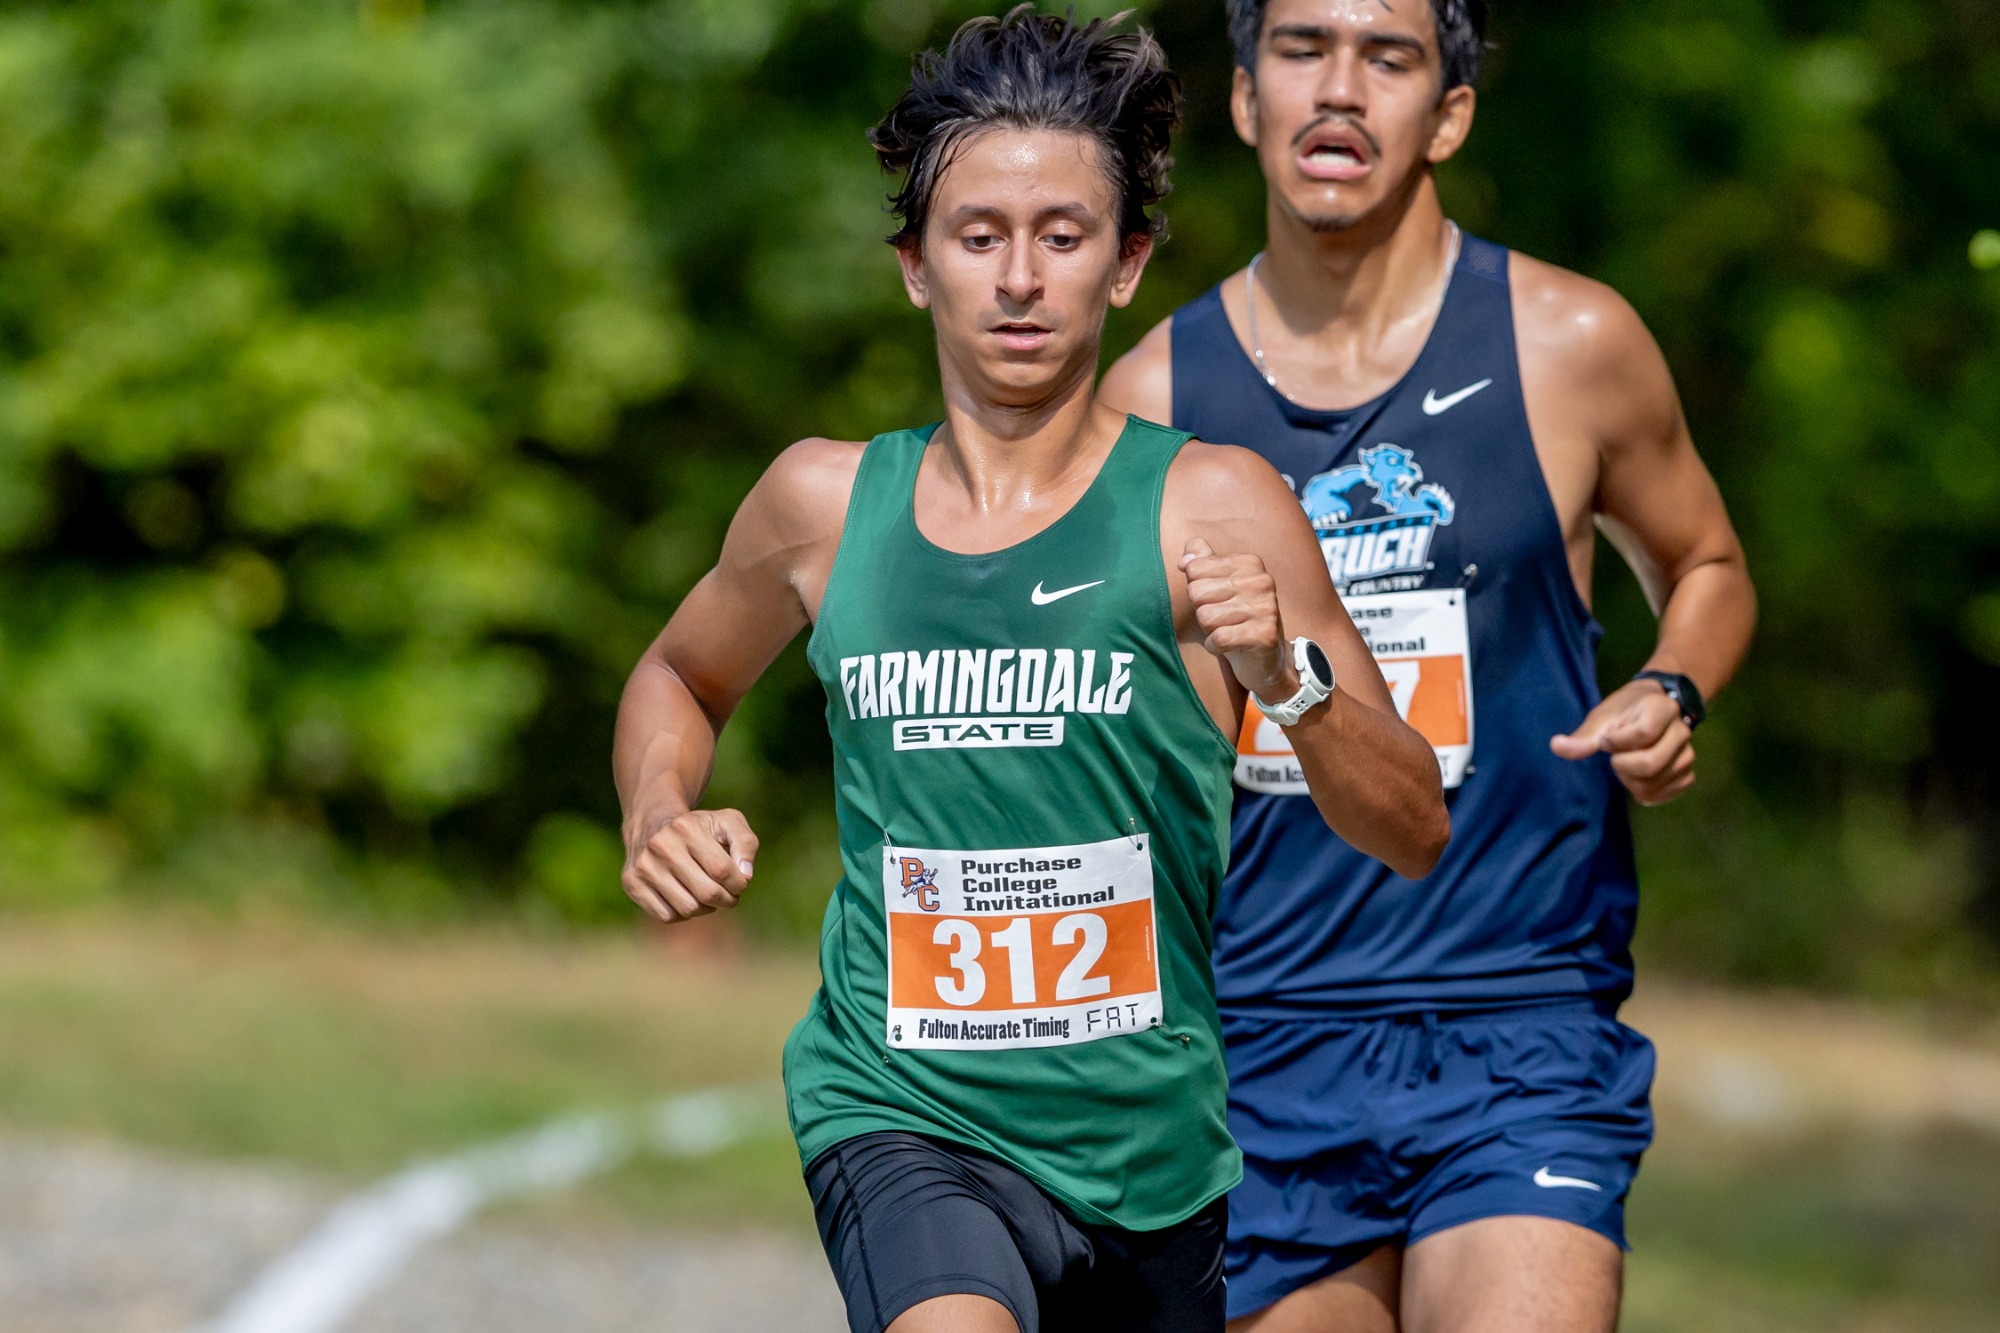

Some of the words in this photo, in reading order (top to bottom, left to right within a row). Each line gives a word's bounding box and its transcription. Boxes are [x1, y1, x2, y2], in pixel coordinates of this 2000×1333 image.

[1320, 525, 1431, 583] RUCH
[840, 648, 1135, 720] FARMINGDALE
[901, 723, 1054, 744] STATE
[961, 857, 1082, 875] Purchase
[962, 877, 1057, 894] College
[963, 886, 1115, 912] Invitational
[932, 913, 1111, 1006] 312
[918, 1018, 959, 1039] Fulton
[960, 1018, 1020, 1040] Accurate
[1022, 1016, 1070, 1038] Timing
[1086, 1002, 1140, 1033] FAT
